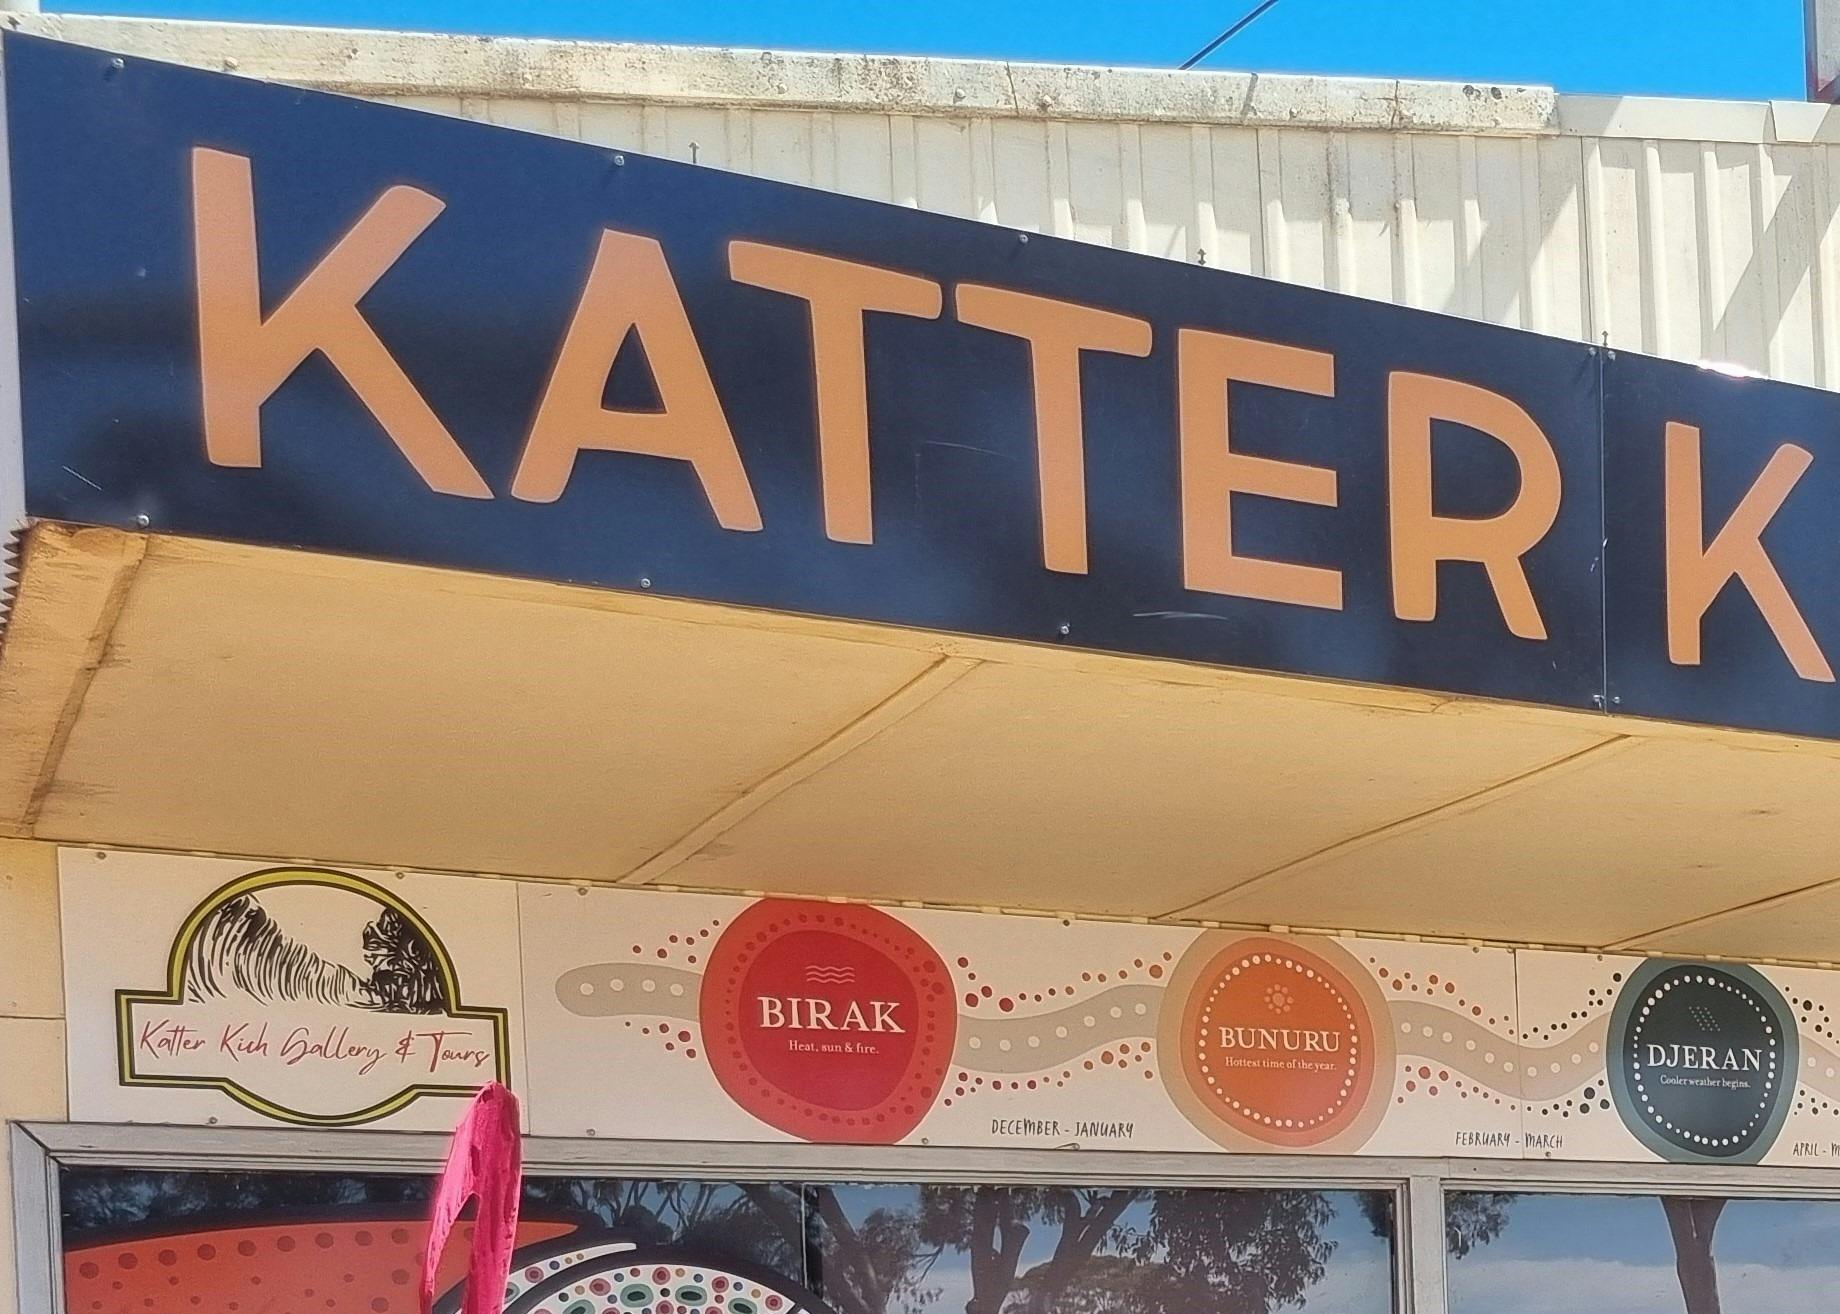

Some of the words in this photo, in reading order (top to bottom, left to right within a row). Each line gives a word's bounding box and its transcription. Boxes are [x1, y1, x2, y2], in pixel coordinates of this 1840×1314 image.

[191, 146, 1562, 640] KATTER
[757, 996, 905, 1033] BIRAK
[140, 1020, 206, 1059] Katter
[220, 1023, 267, 1062] Kich
[280, 1025, 387, 1075] Gallery
[396, 1028, 416, 1063] &
[416, 1031, 490, 1072] Tours
[822, 1044, 841, 1052] sun
[845, 1042, 856, 1053] &
[1219, 1026, 1340, 1052] BUNURU
[1225, 1057, 1260, 1067] Hottest
[1263, 1059, 1285, 1068] time
[1287, 1059, 1297, 1069] of
[1298, 1060, 1313, 1069] the
[1312, 1062, 1336, 1072] year.
[1646, 1044, 1762, 1071] DJERAN
[1660, 1074, 1688, 1085] Cooler
[1688, 1076, 1720, 1086] weather
[992, 1118, 1060, 1136] DECEMBER
[1074, 1121, 1134, 1138] JANUARY
[1456, 1131, 1510, 1147] FEBRUARY
[1525, 1132, 1562, 1148] MARCH
[1793, 1142, 1819, 1156] APRIL
